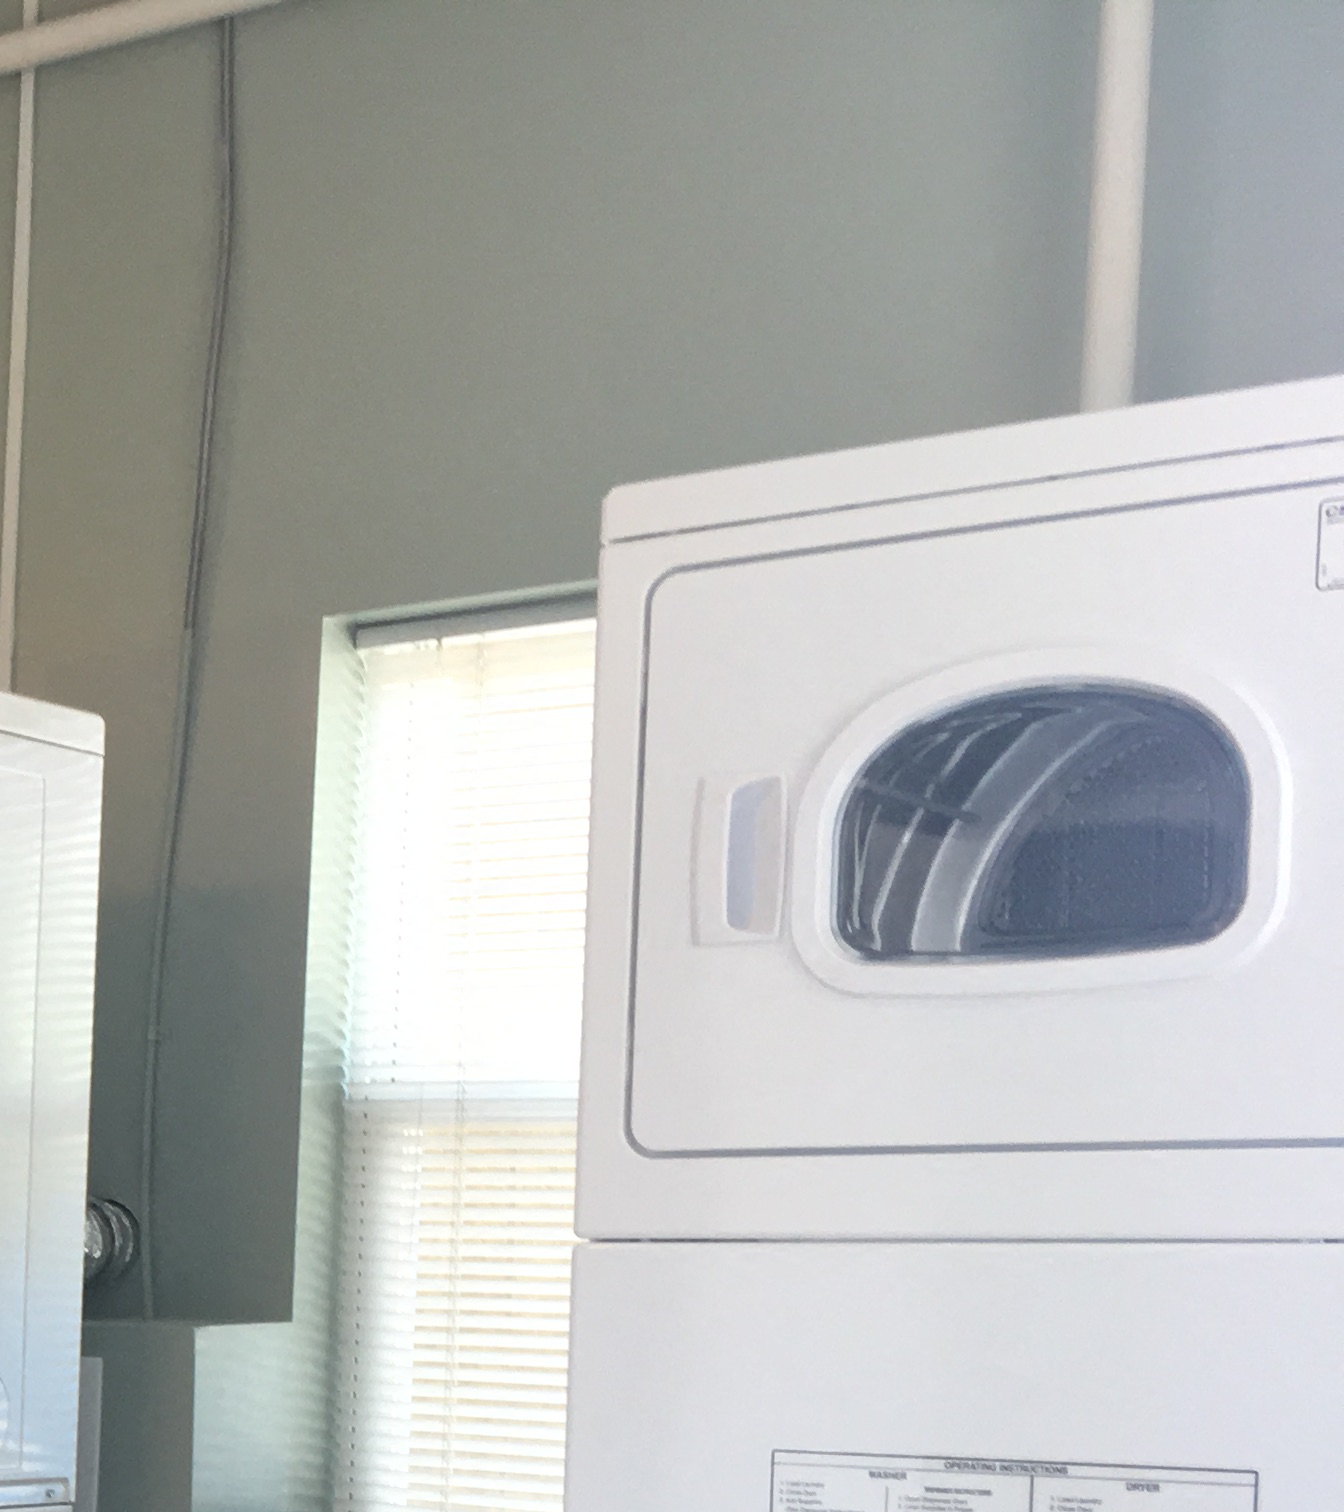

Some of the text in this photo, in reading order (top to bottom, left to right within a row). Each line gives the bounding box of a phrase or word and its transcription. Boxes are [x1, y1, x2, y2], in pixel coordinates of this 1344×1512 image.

[944, 1461, 1068, 1475] OPERATING INSTRUCTIONS
[869, 1470, 907, 1480] WASHER
[1126, 1481, 1160, 1493] DRYER
